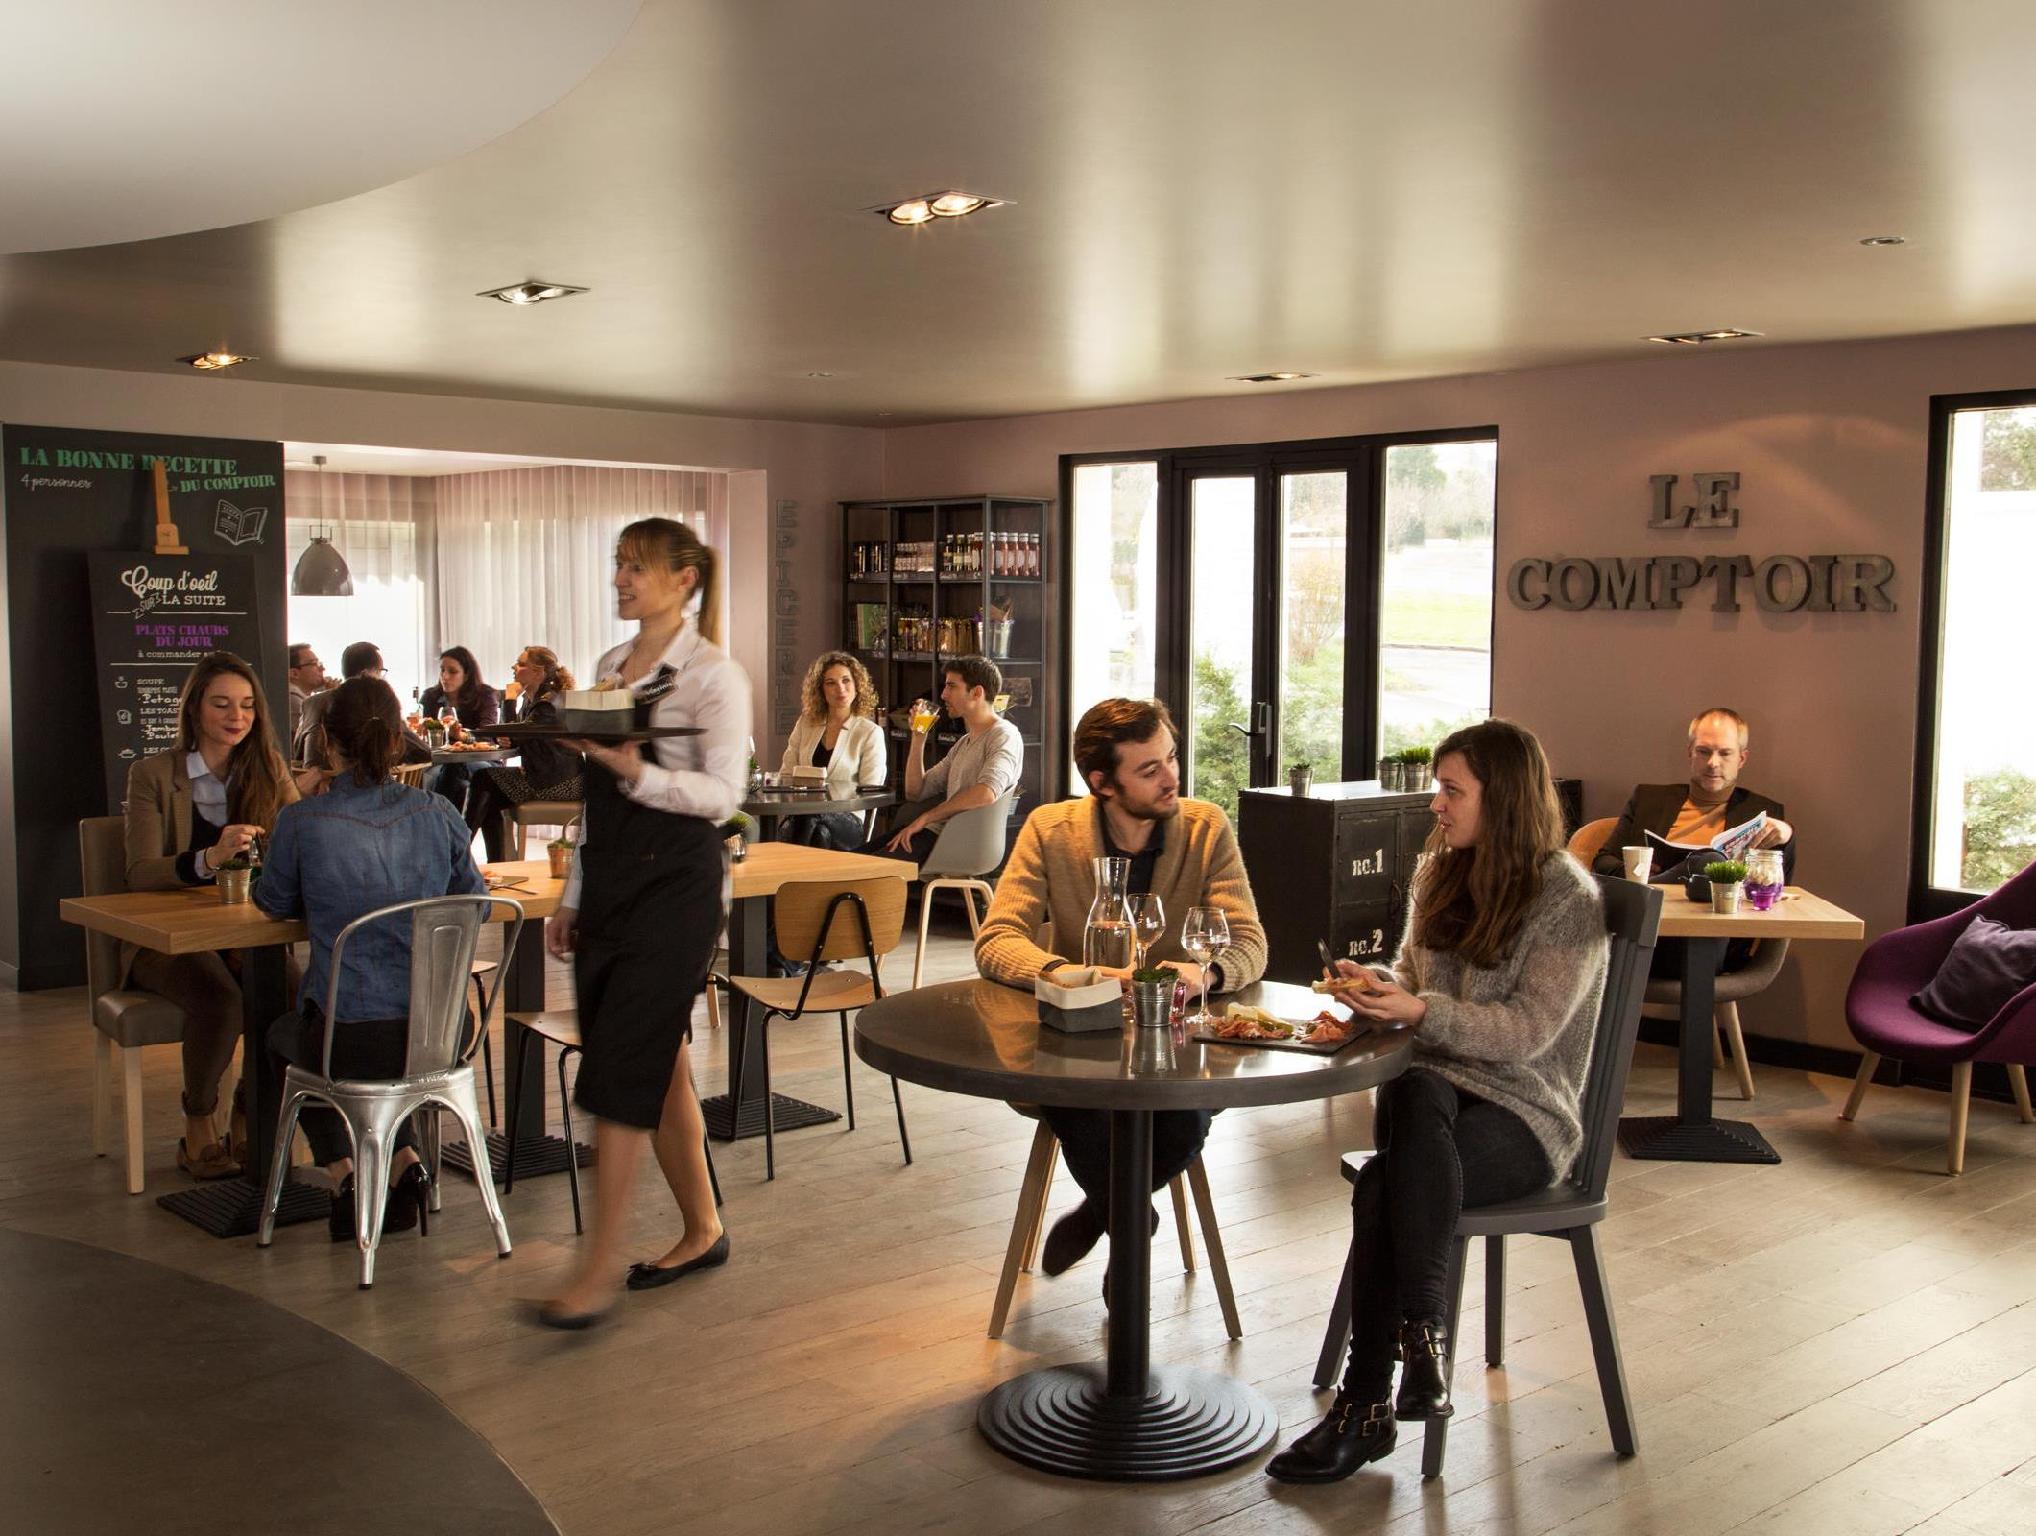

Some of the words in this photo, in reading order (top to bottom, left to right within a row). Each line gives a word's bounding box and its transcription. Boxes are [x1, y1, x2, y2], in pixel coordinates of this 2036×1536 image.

[20, 446, 49, 466] LA
[56, 448, 135, 470] BONNE
[21, 473, 29, 488] 4
[180, 479, 201, 493] DU
[203, 474, 276, 491] COMPTOIR
[1648, 472, 1740, 529] LE
[121, 565, 175, 599] Coup
[177, 570, 218, 592] d'oeil
[1507, 554, 1897, 613] COMPTOIR
[161, 595, 181, 605] LA
[183, 595, 226, 606] SUITE
[135, 625, 176, 635] PLATS
[179, 625, 230, 635] CHAUDS
[156, 636, 175, 647] DU
[178, 636, 213, 647] JOUR
[146, 650, 202, 658] commander
[1352, 848, 1383, 877] no.1
[1349, 928, 1383, 957] no.2
